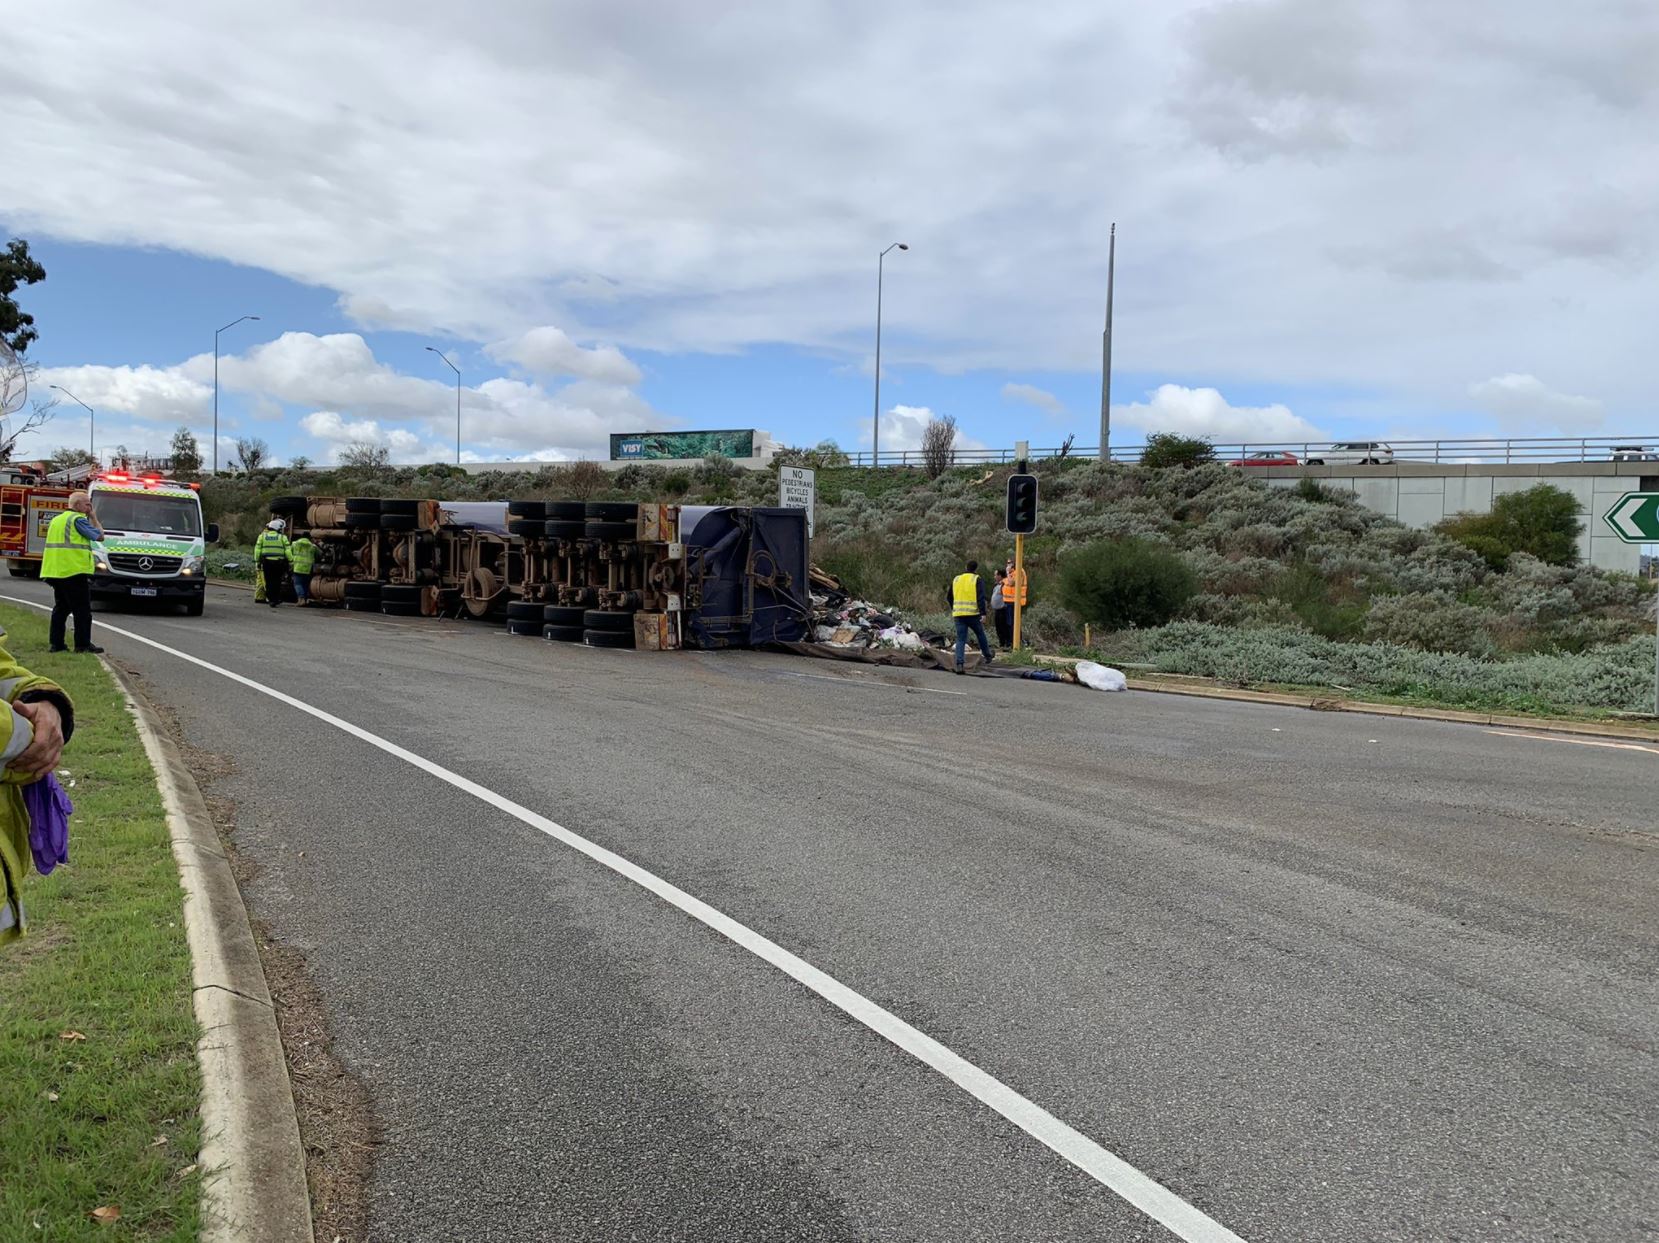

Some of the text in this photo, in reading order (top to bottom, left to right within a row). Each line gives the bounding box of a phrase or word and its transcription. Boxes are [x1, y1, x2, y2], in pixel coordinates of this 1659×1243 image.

[792, 470, 803, 479] NO
[782, 478, 813, 488] PEDESTRIANS
[786, 487, 809, 496] BICYCLES
[787, 495, 808, 504] ANIMALS
[36, 500, 69, 509] FIRE
[116, 540, 178, 550] AMBULANCE
